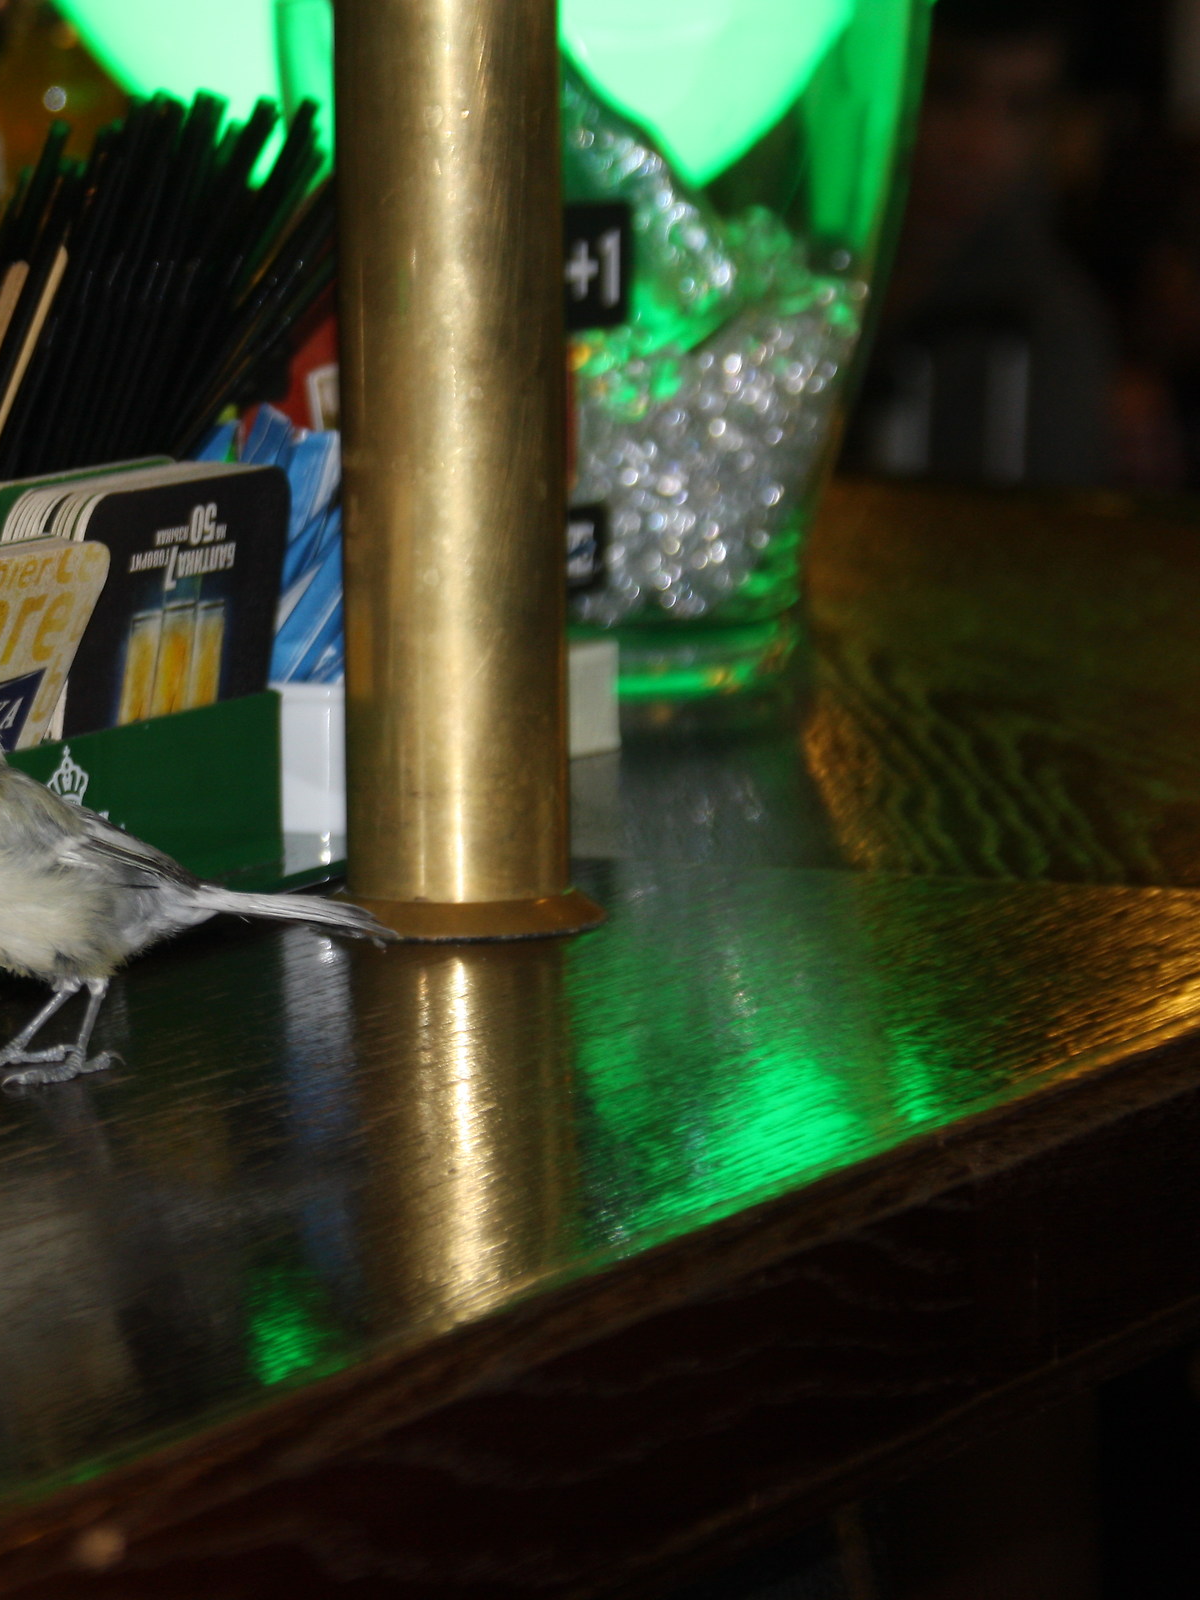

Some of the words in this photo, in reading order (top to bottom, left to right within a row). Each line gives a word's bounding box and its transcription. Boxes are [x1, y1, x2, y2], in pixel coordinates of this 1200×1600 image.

[189, 502, 218, 546] 50
[128, 548, 170, 574] ГОВОРИТ
[163, 545, 179, 592] 7
[177, 541, 237, 579] БАЛТИКА
